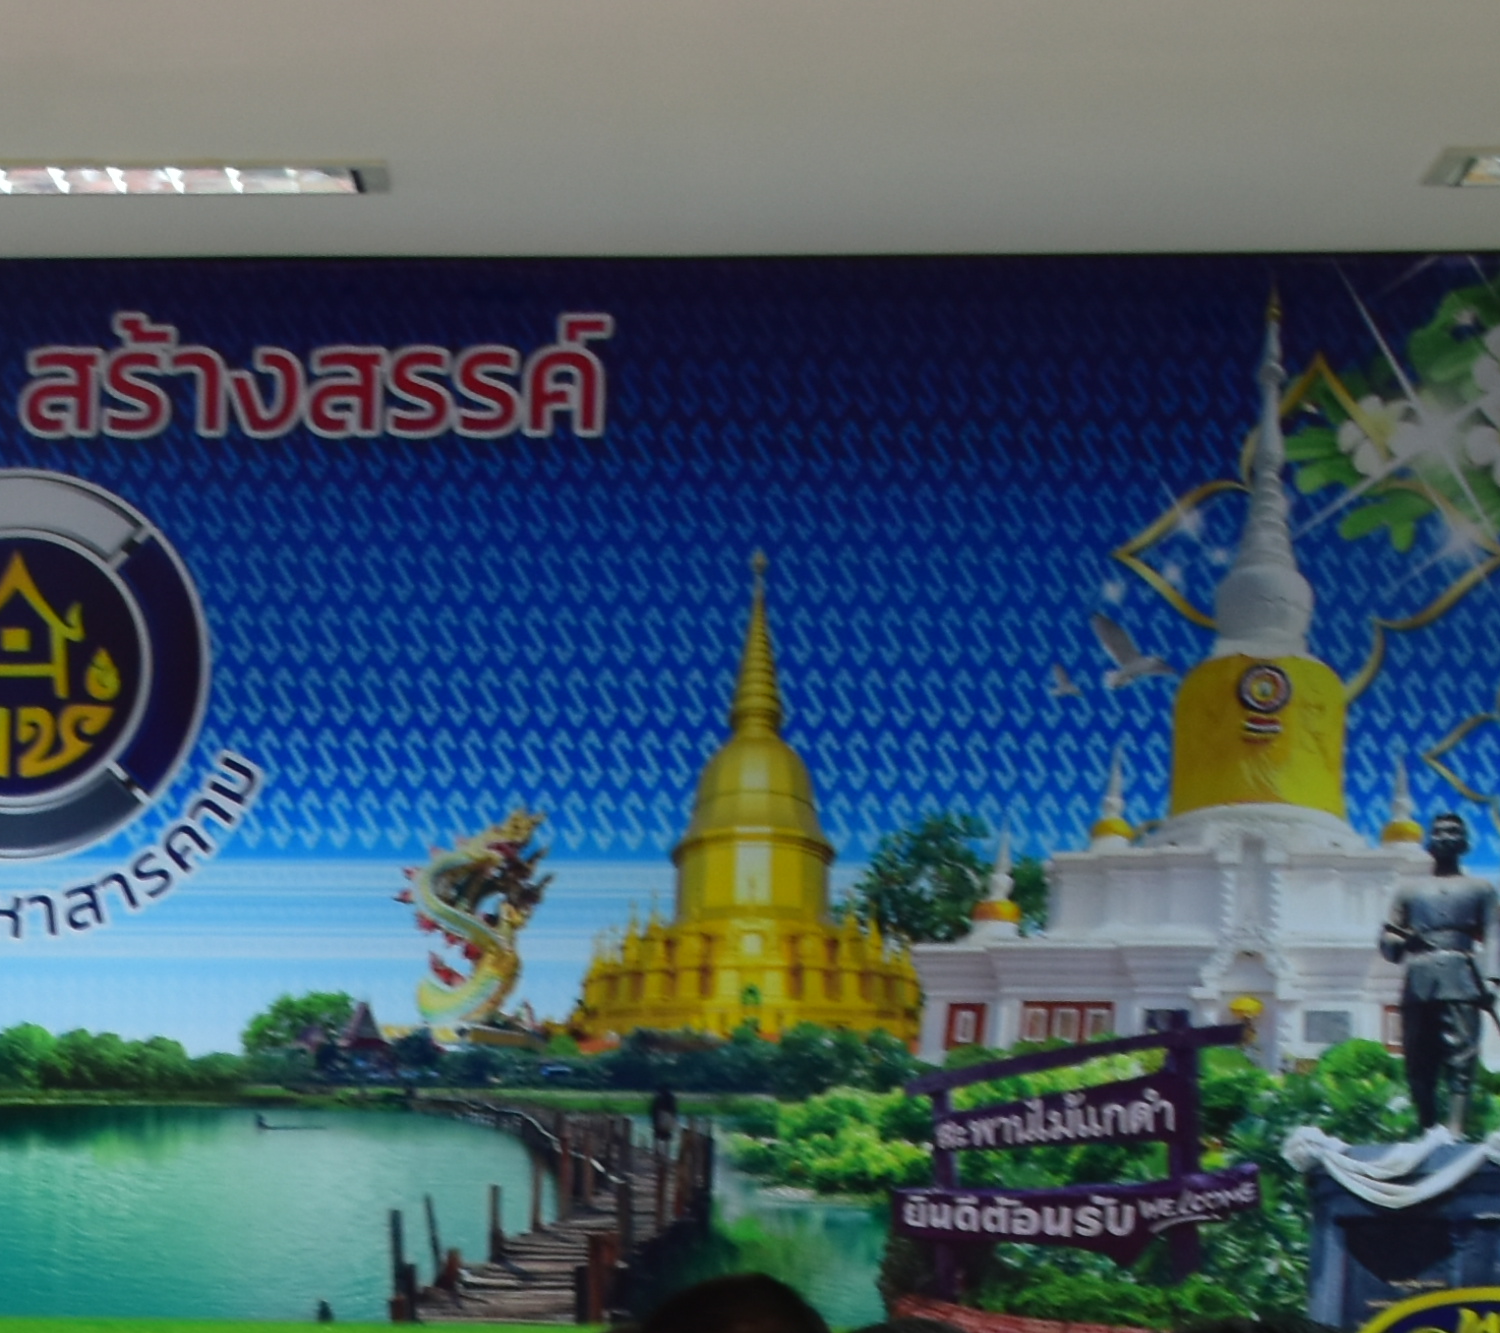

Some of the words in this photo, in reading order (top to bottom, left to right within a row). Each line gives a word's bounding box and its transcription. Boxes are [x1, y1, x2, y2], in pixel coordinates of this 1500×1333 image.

[20, 313, 612, 439] สร้างสรรค์
[902, 1195, 1138, 1238] ยินดีต้อนรับ
